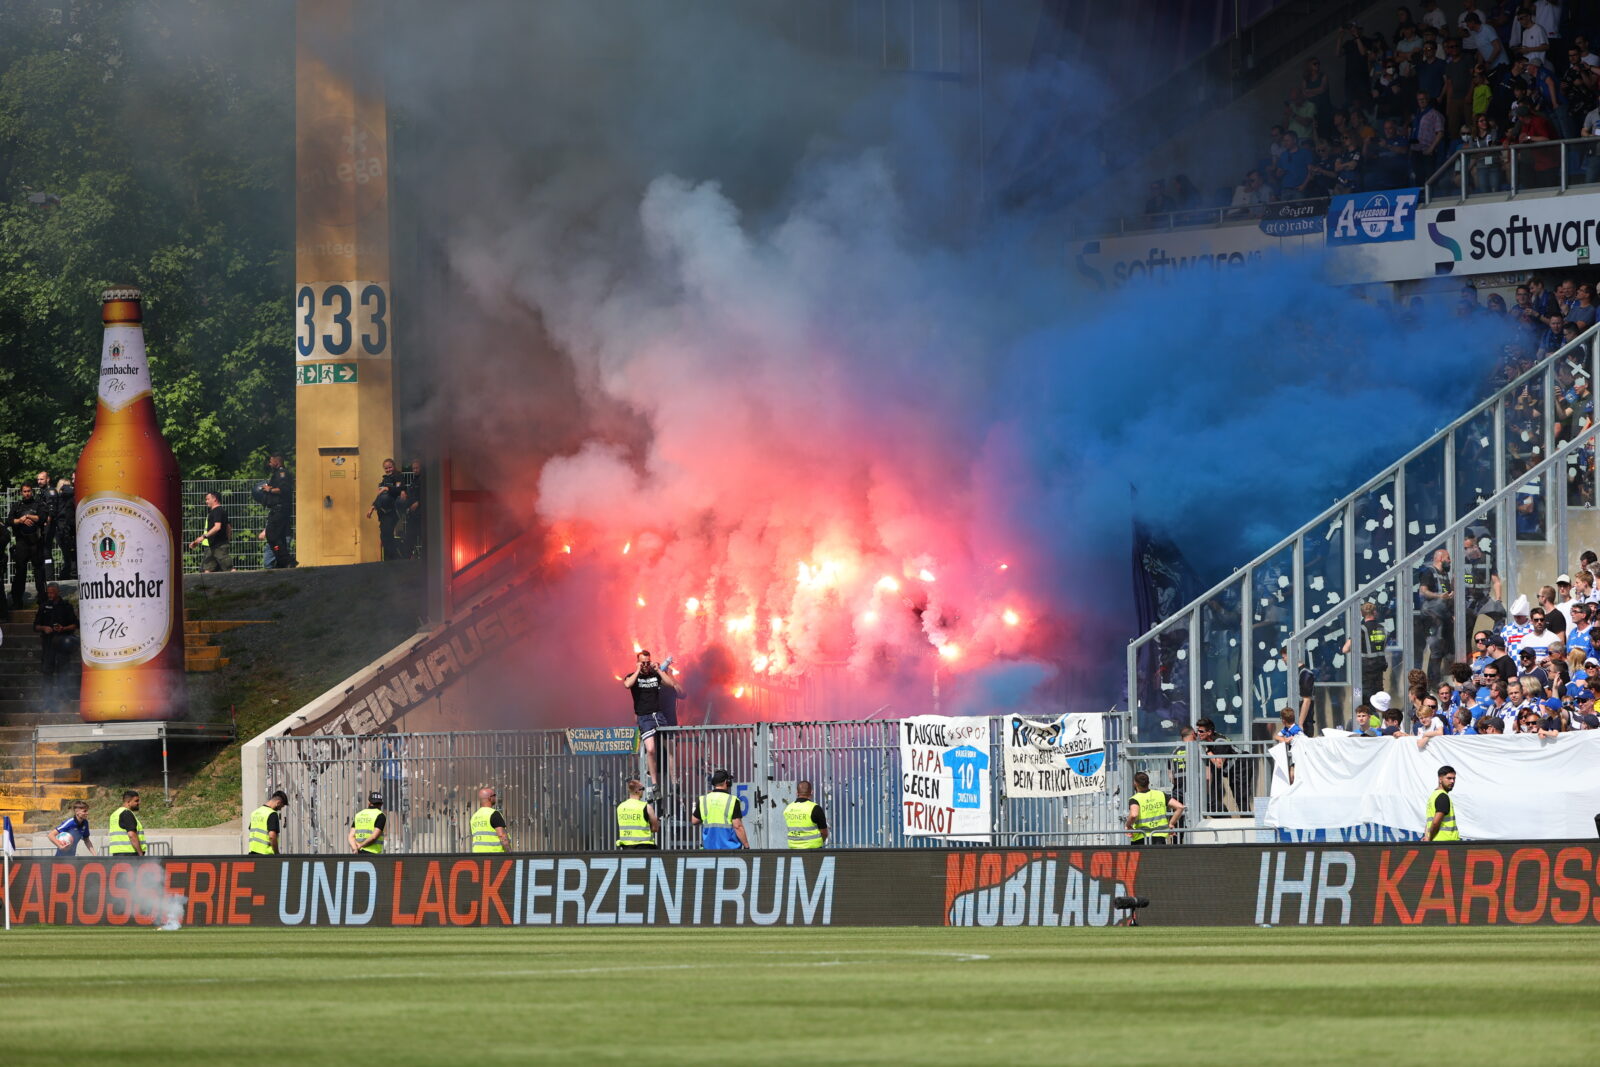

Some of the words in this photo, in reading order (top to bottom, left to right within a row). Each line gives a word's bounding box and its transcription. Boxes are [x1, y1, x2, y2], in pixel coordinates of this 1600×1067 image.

[1279, 205, 1314, 217] Gegen
[1354, 208, 1388, 220] PADERBORN
[1470, 215, 1600, 261] softwar
[298, 285, 387, 356] 333
[107, 378, 126, 393] Pils
[80, 572, 163, 600] rombacher
[92, 616, 128, 643] Pils
[570, 728, 604, 739] SCHNAPS
[605, 729, 611, 739] &
[613, 728, 635, 739] WEED
[904, 722, 949, 747] TAUSCHE
[911, 749, 942, 774] PAPA
[904, 773, 940, 799] GEGEN
[958, 763, 974, 790] 10
[1013, 770, 1034, 791] DEIN
[1038, 768, 1071, 792] TRIKOT
[904, 801, 955, 834] TRIKOT
[279, 861, 377, 925] UND
[391, 856, 836, 925] LACKIERZENTRUM
[944, 851, 1141, 926] MOBILACK
[1255, 851, 1356, 924] IHR
[1373, 846, 1600, 924] KAROS
